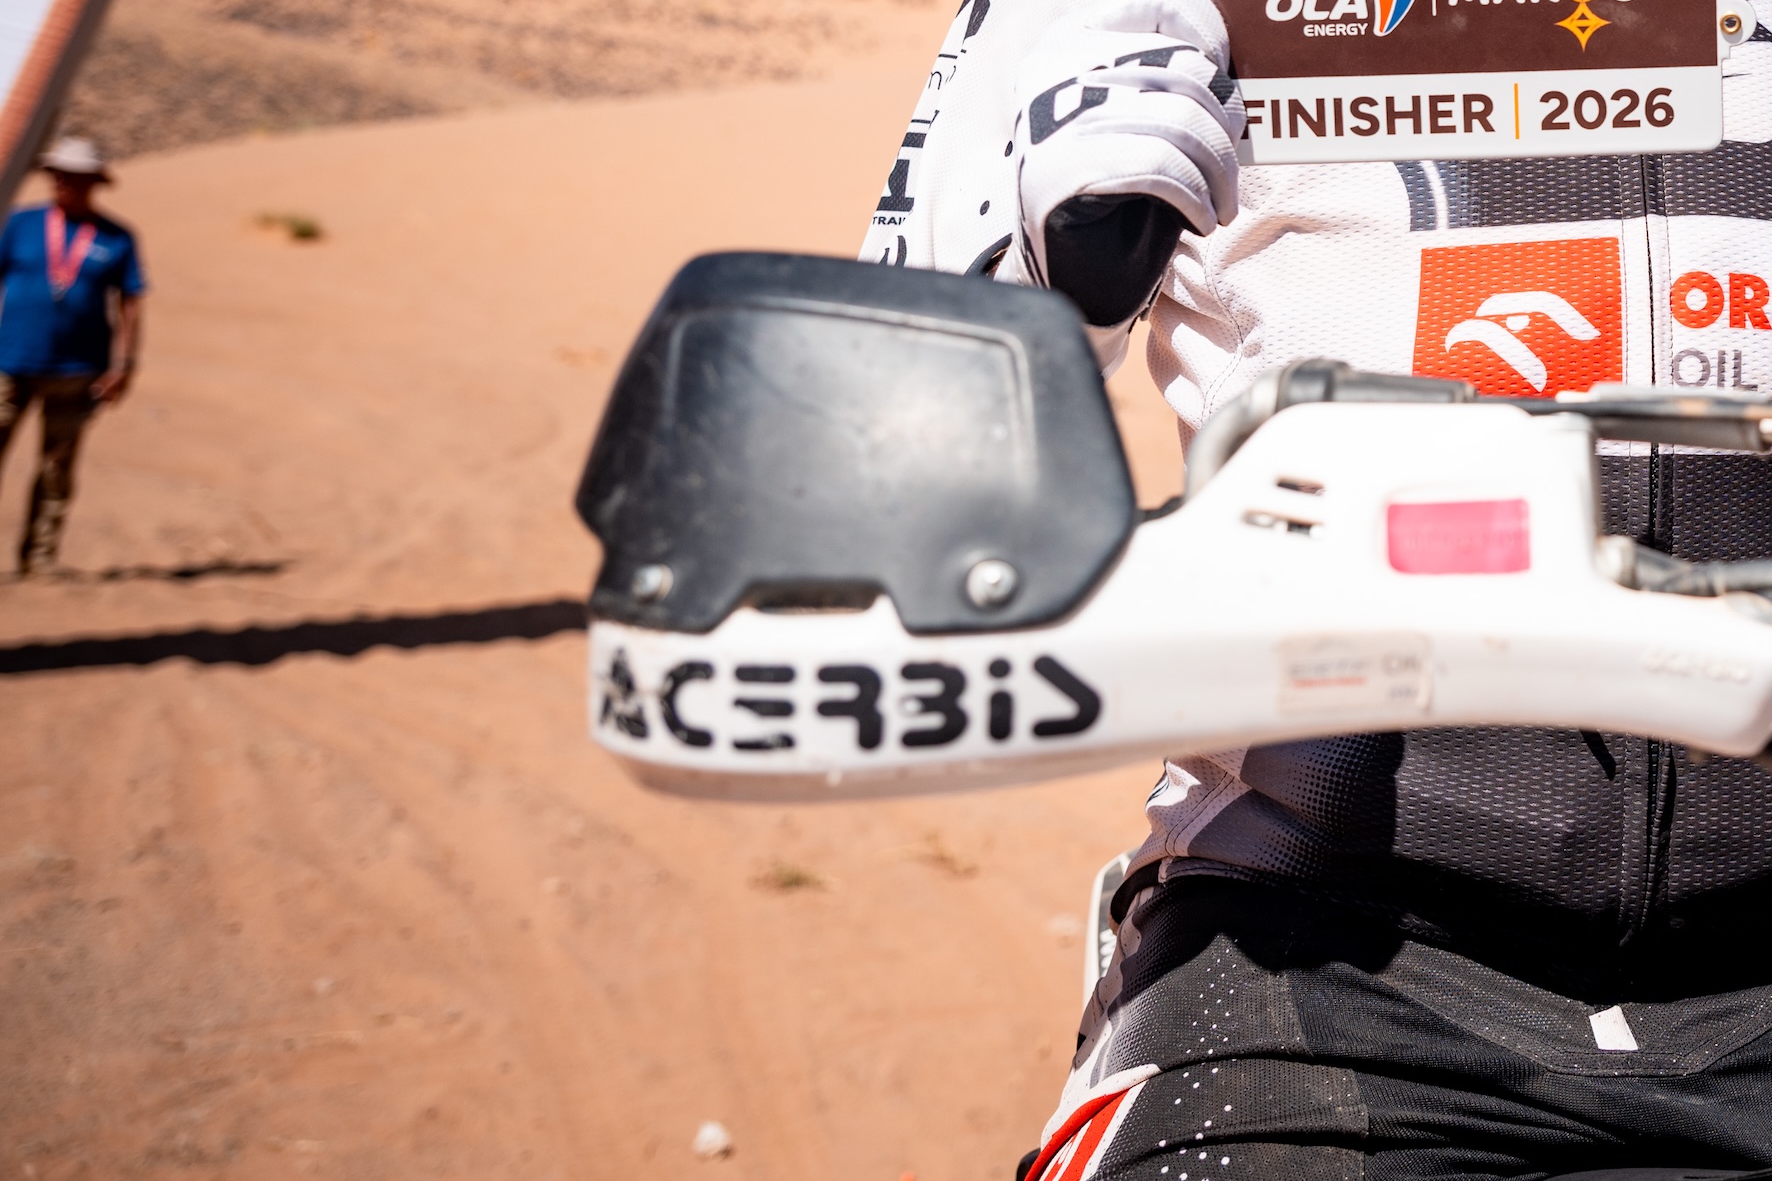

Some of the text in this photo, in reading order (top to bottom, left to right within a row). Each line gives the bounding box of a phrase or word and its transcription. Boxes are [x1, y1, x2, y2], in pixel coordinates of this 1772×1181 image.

[1303, 23, 1368, 37] ENERGY
[1244, 94, 1496, 141] FINISHER
[1539, 87, 1675, 131] 2026
[1673, 348, 1759, 391] OIL
